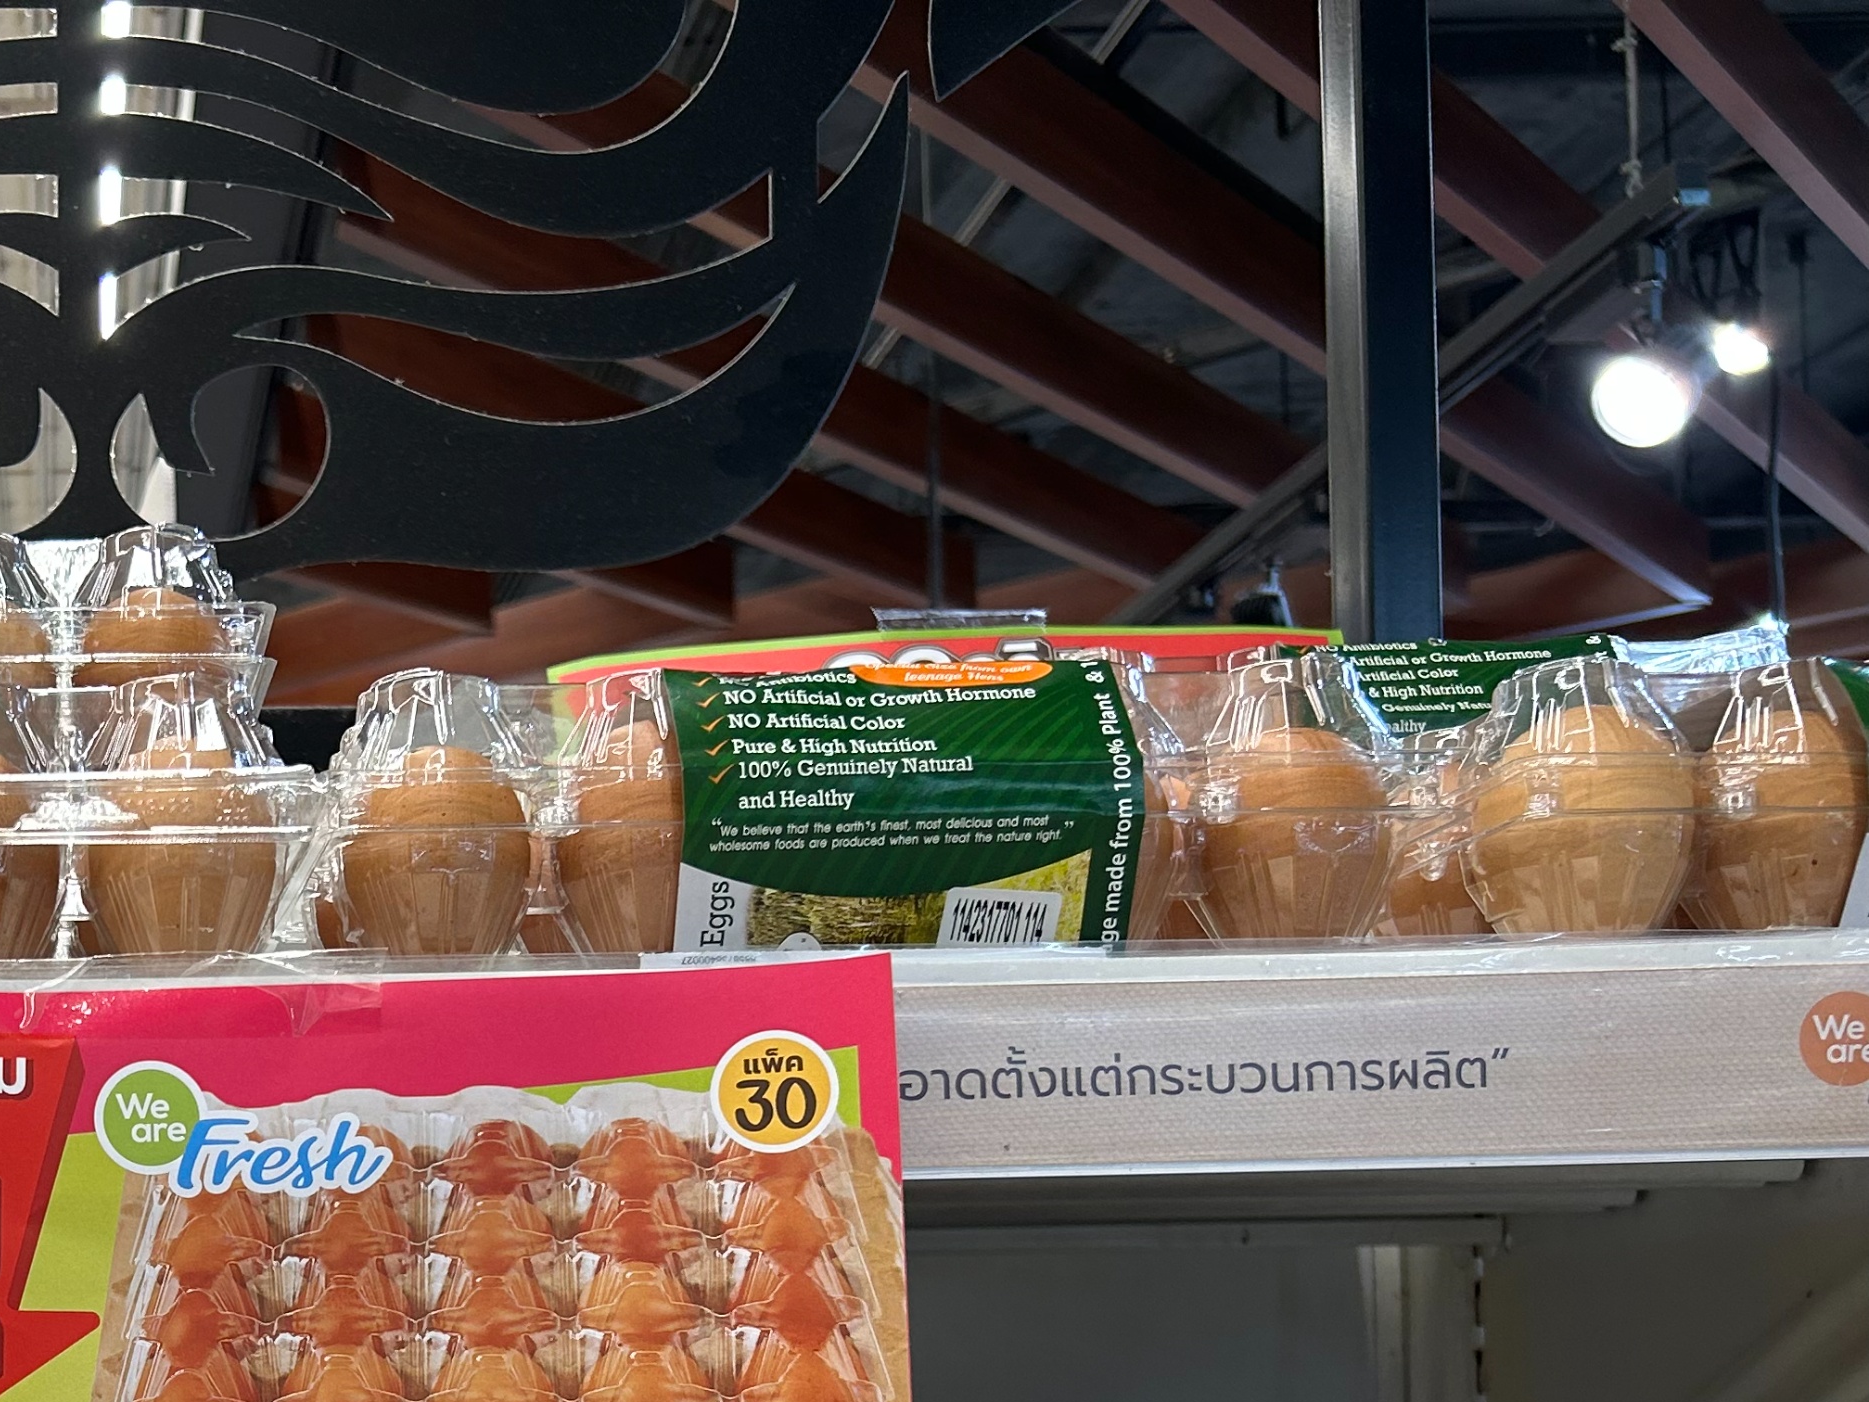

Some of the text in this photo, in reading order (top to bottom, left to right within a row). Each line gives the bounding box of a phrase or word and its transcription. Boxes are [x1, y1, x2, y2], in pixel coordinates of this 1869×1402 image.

[1430, 652, 1480, 665] Growth
[1485, 649, 1551, 662] Hormone
[724, 686, 1036, 706] NO Artificial or Growth Hormone
[728, 714, 905, 730] NO Artificial Color
[732, 738, 937, 756] Pure & High Nutrition
[739, 757, 973, 779] 100% Genuinely Natural
[739, 791, 854, 811] and Healthy
[1099, 693, 1132, 913] made from 100% Plant
[742, 823, 783, 835] believe
[787, 823, 809, 834] that
[813, 822, 832, 833] the
[880, 819, 911, 832] finest,
[916, 818, 942, 831] most
[946, 817, 994, 831] delicious
[998, 817, 1019, 828] and
[1023, 816, 1049, 827] most
[701, 881, 734, 946] Eggs
[1813, 1015, 1866, 1041] We
[743, 1048, 804, 1073] แพ็ค
[116, 1093, 169, 1121] We
[735, 1077, 816, 1130] 30
[131, 1119, 186, 1143] are
[176, 1118, 384, 1190] Fresh
